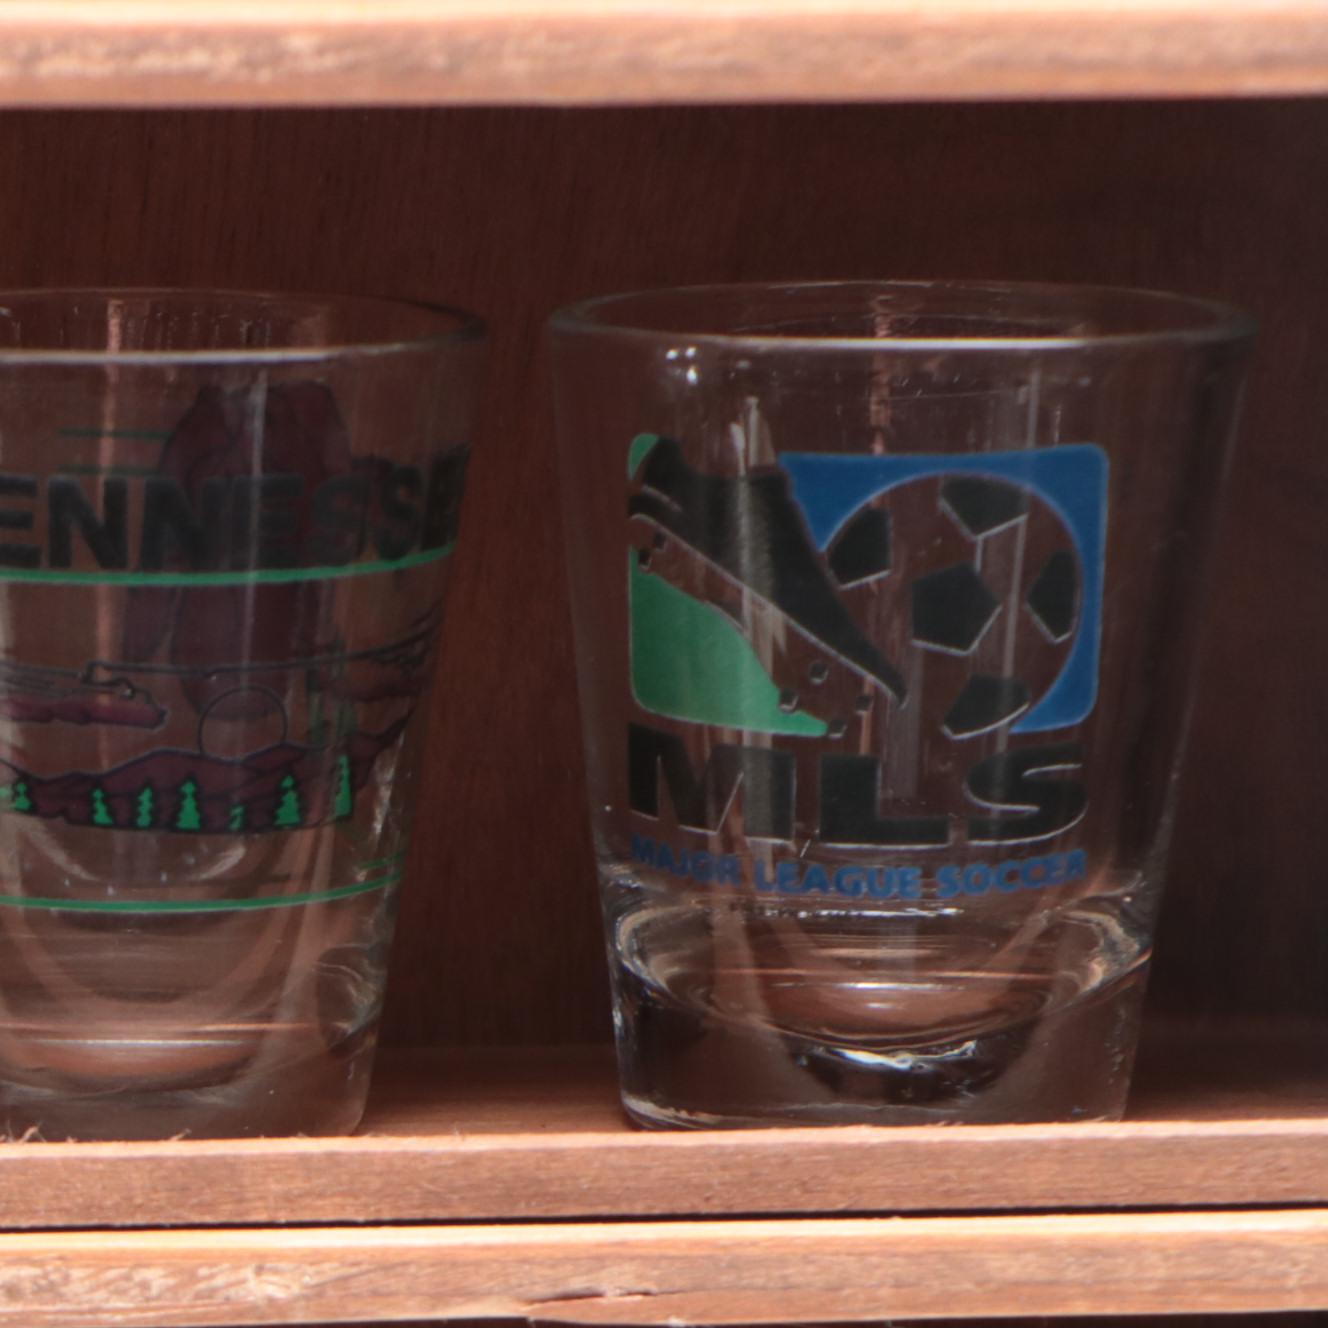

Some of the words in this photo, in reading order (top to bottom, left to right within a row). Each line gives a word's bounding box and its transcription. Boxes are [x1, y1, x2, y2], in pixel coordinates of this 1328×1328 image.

[628, 721, 1090, 850] MLS
[630, 834, 743, 887] MAJOR
[753, 857, 924, 900] LEAGUE
[936, 848, 1090, 900] SOCCER
